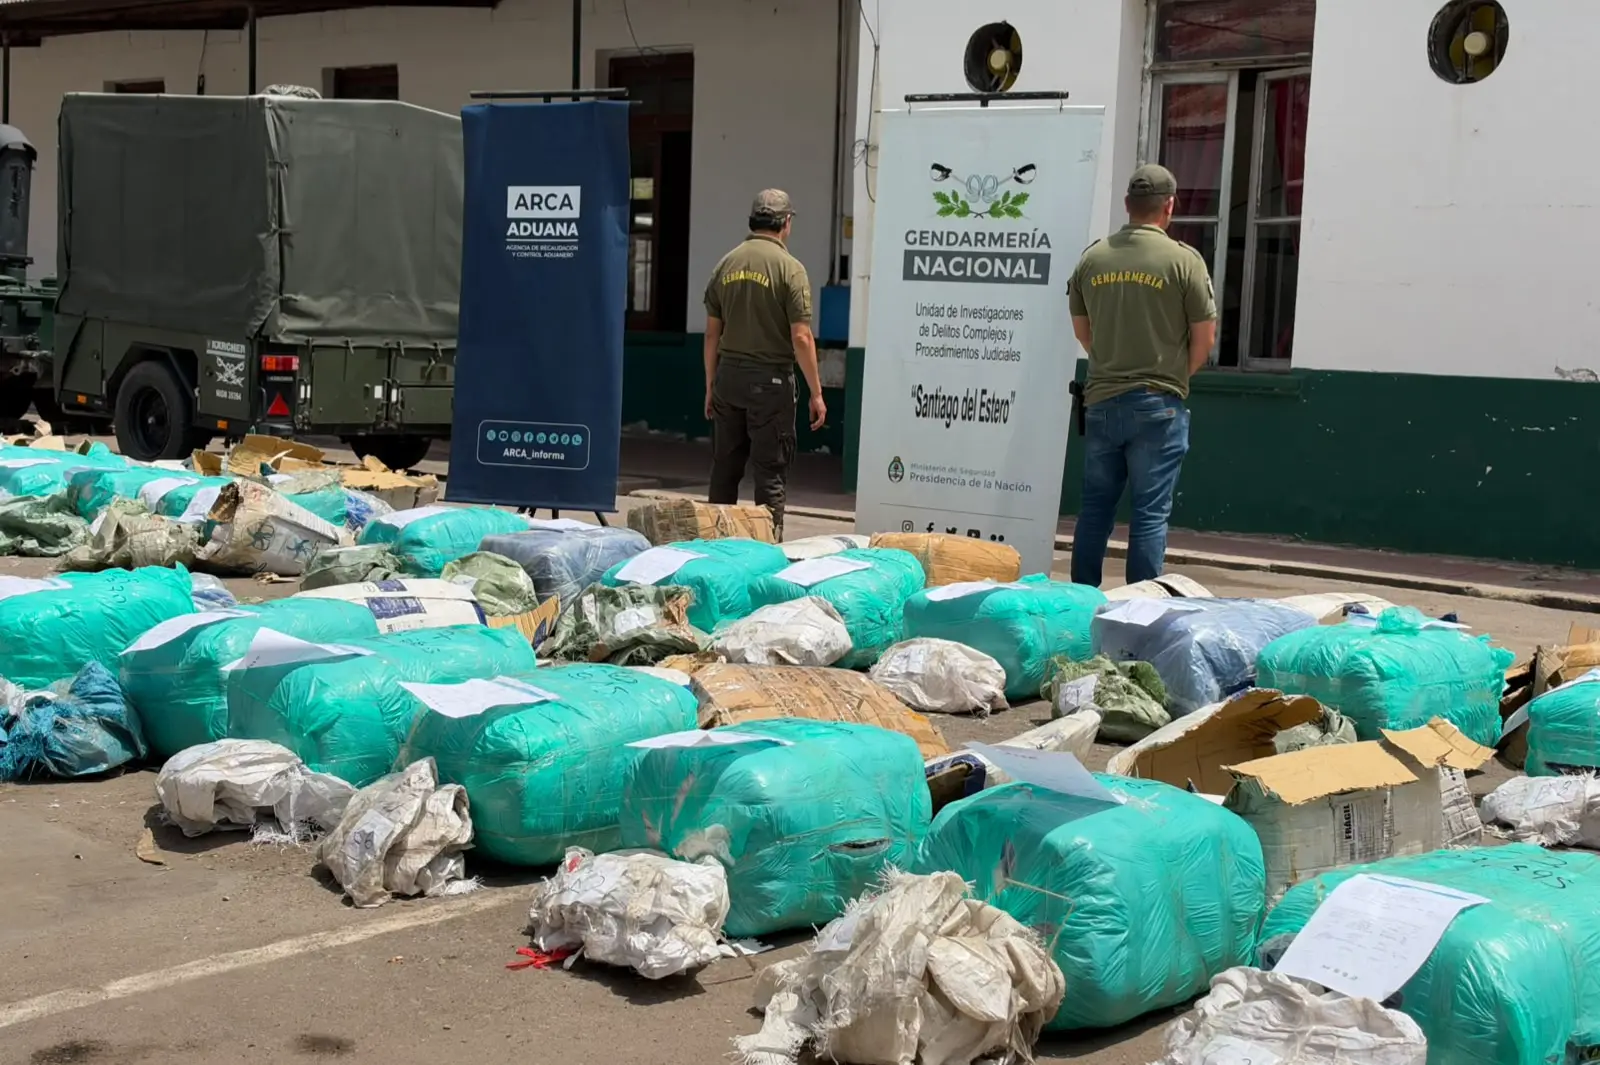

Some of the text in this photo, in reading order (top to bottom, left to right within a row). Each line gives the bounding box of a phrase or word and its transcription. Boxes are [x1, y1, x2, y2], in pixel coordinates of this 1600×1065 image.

[514, 193, 574, 211] ARCA
[506, 222, 579, 236] ADUANA
[904, 228, 1052, 249] GENDARMERÍA
[913, 256, 1042, 279] NACIONAL
[1091, 270, 1164, 290] GENDARMERIA
[916, 302, 1024, 322] Unidad de Investigaciones
[919, 323, 1014, 344] de Delitos Complejos y
[915, 342, 1021, 362] Procedimientos Judiciales
[961, 388, 978, 422] del
[503, 448, 565, 460] ARCA_informa
[910, 462, 996, 478] Ministerio de Seguridad
[910, 472, 1032, 493] Presidencia de la Nación
